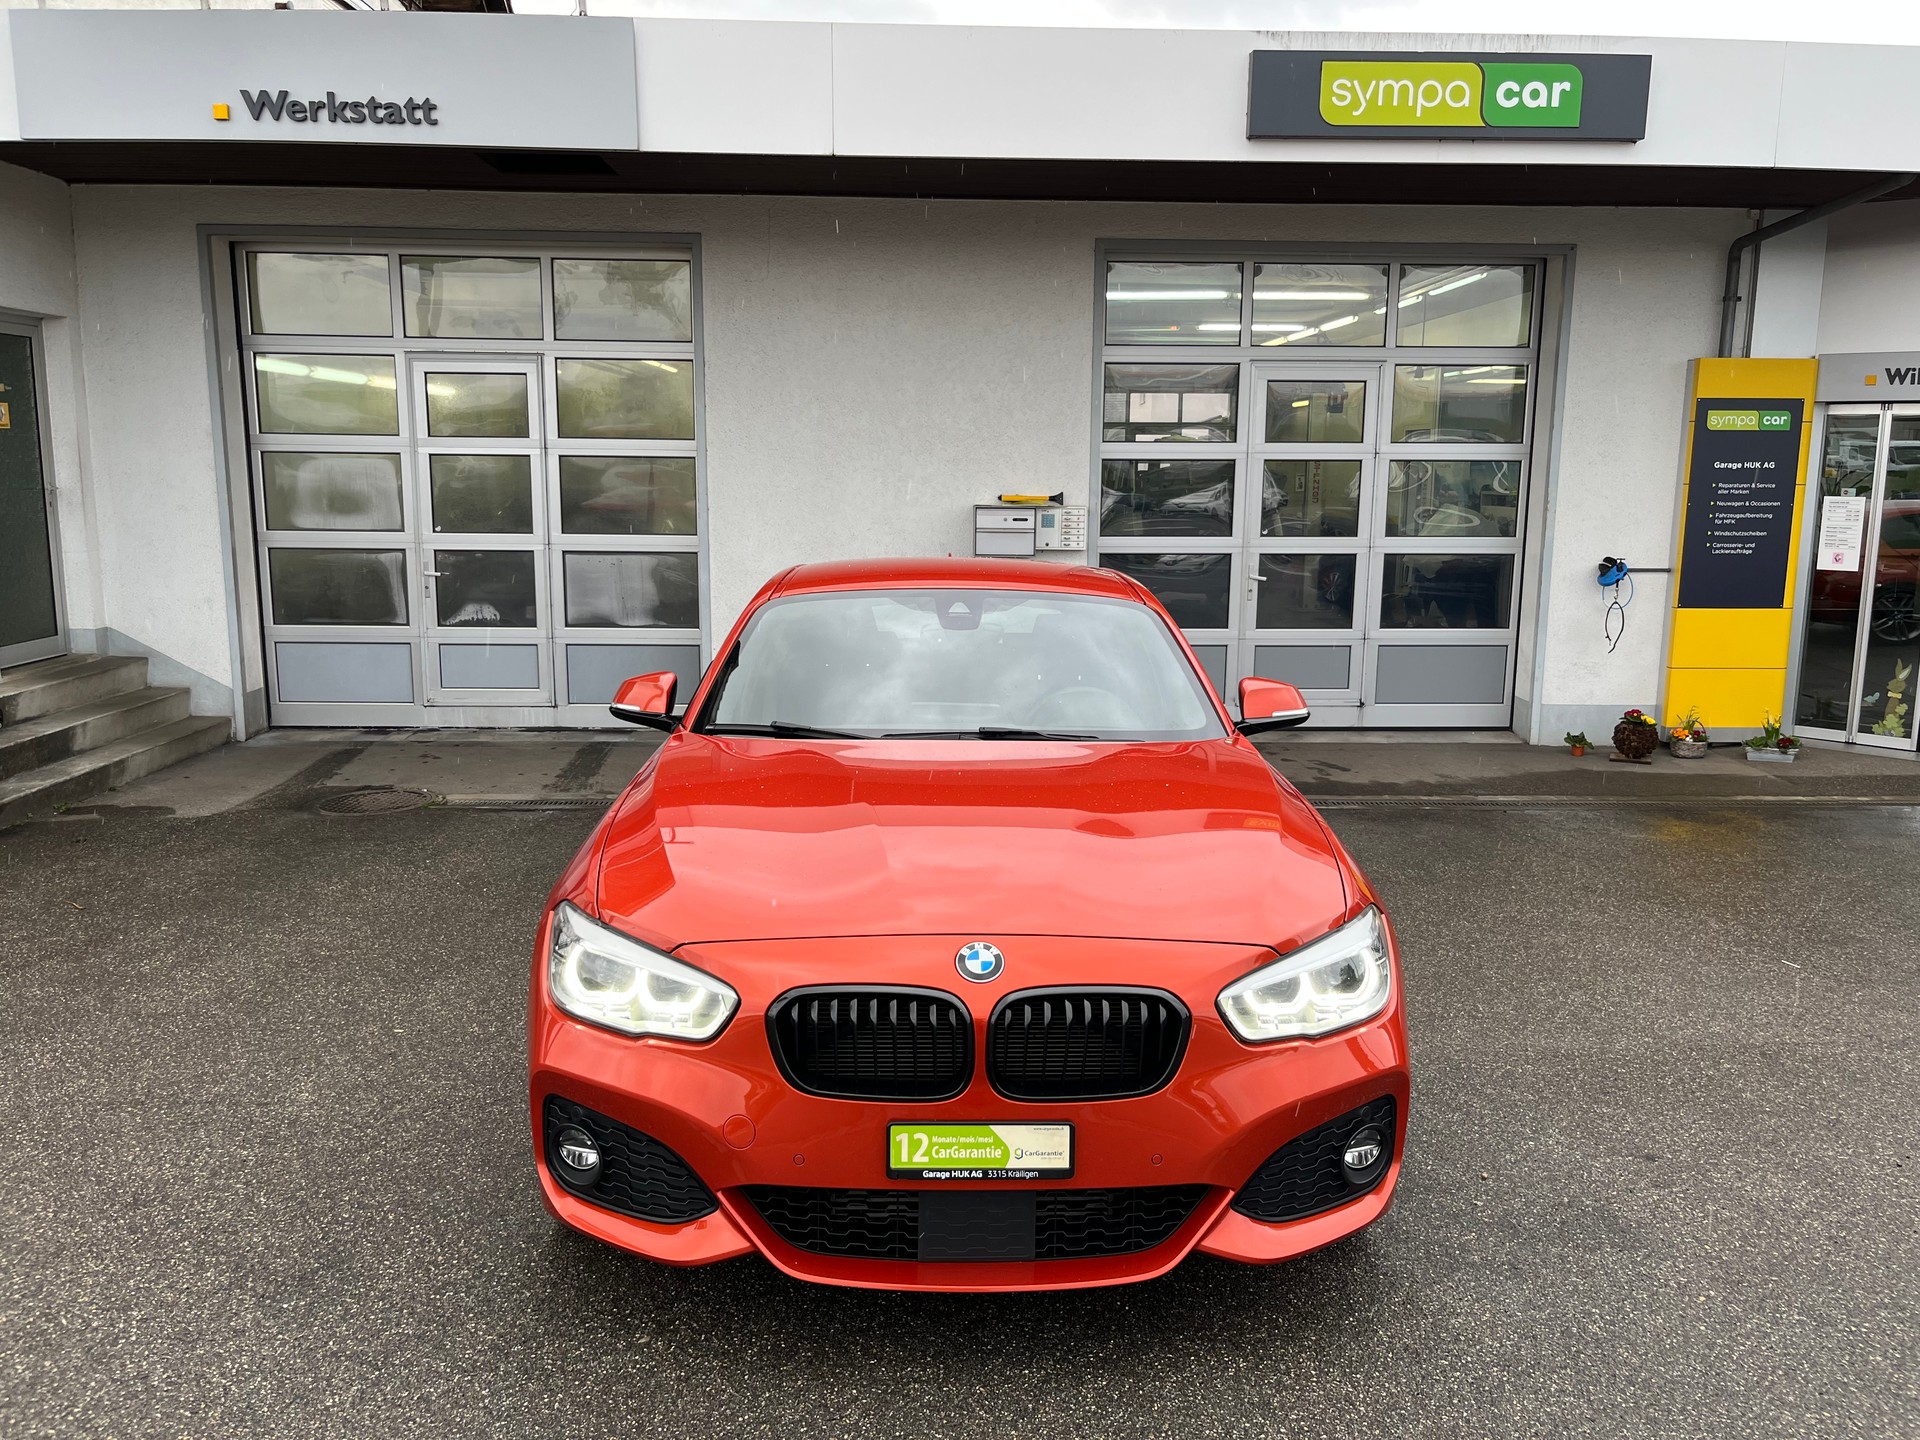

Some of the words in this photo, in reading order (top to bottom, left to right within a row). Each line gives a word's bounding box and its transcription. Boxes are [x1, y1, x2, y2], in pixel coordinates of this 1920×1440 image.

[1331, 78, 1471, 118] sympa
[1496, 81, 1571, 108] car
[239, 89, 439, 126] Werkstatt
[1710, 415, 1756, 428] sympa
[1762, 415, 1788, 425] car
[1713, 461, 1742, 470] Garage
[1744, 461, 1762, 469] HUK
[1762, 461, 1776, 469] AG
[895, 1132, 929, 1163] 12
[932, 1145, 1003, 1159] CarGarantie
[922, 1170, 950, 1179] Garage
[951, 1170, 970, 1178] HUK
[971, 1170, 983, 1178] AG
[987, 1170, 1007, 1178] 3315
